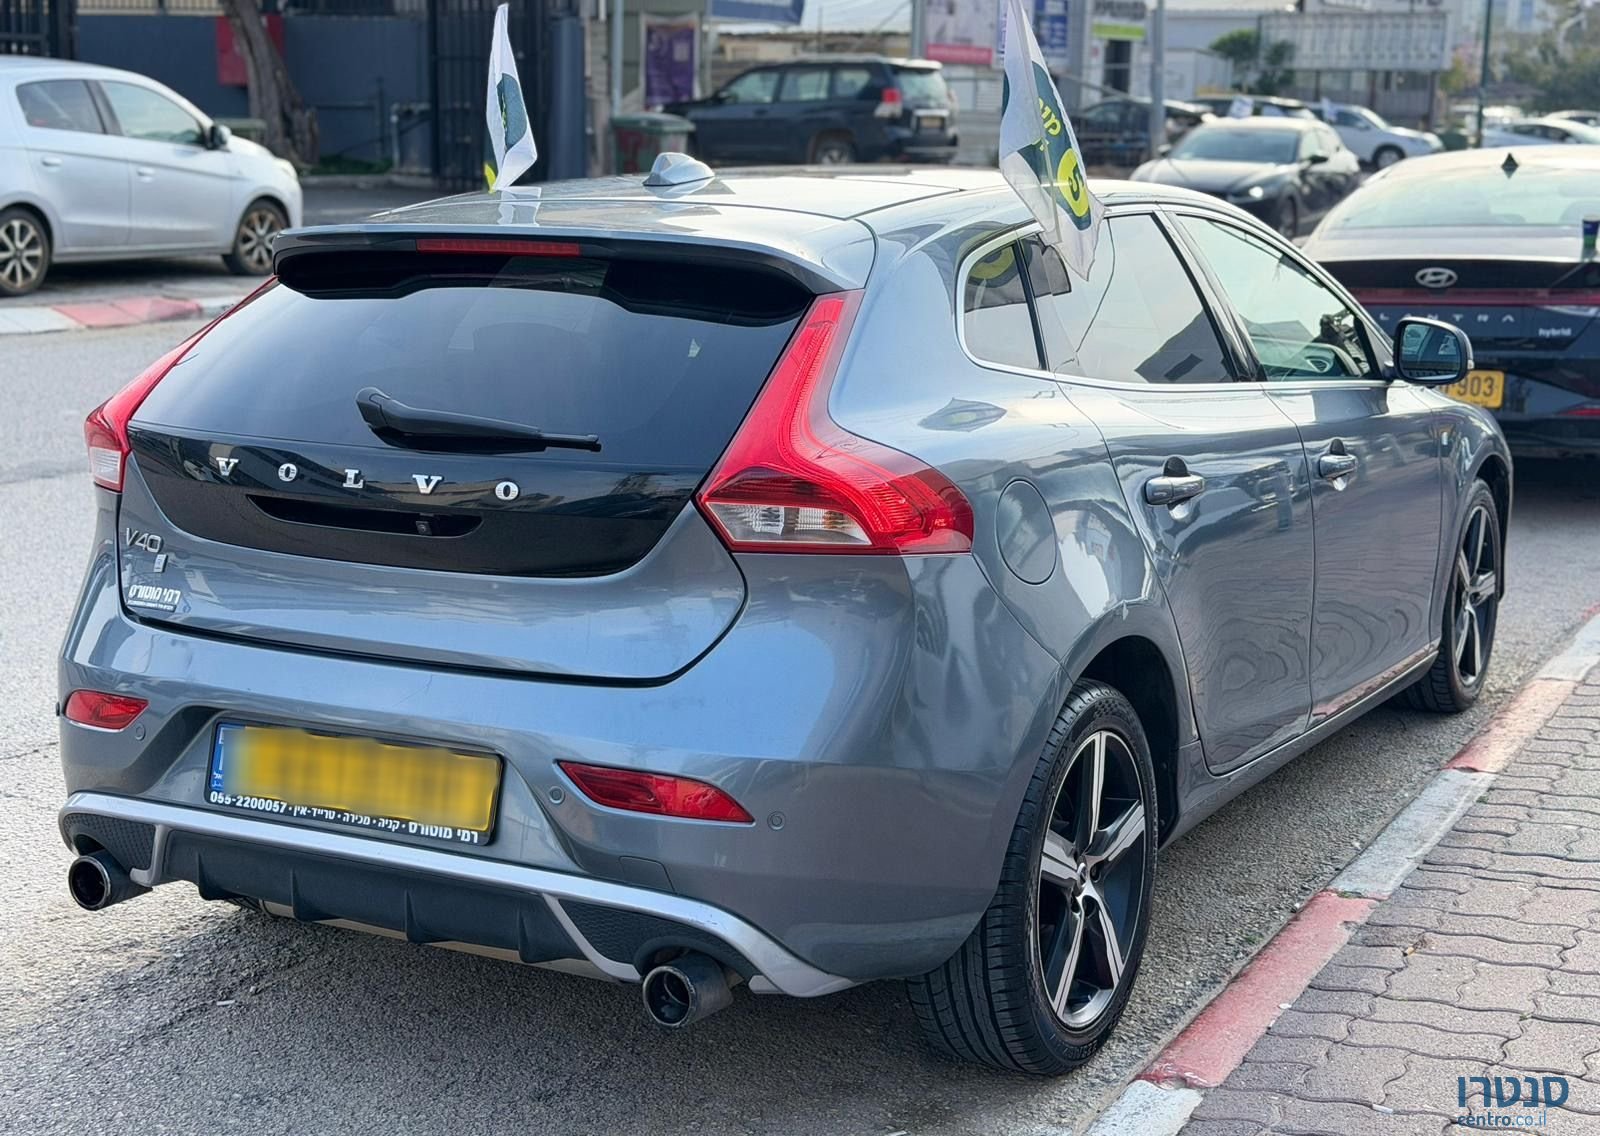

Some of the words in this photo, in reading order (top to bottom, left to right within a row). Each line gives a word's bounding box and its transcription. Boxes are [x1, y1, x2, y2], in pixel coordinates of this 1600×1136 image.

[1538, 327, 1572, 338] hybrid
[216, 457, 520, 501] VOLVO
[126, 527, 162, 553] V40
[128, 584, 163, 601] מוטורס
[162, 588, 181, 605] רמי
[210, 791, 288, 814] 055-2200057
[293, 804, 336, 820] טרייד-אין
[342, 812, 371, 825] מכירה
[378, 818, 400, 832] קניה
[408, 821, 453, 839] מוטורס
[457, 829, 479, 844] רמי
